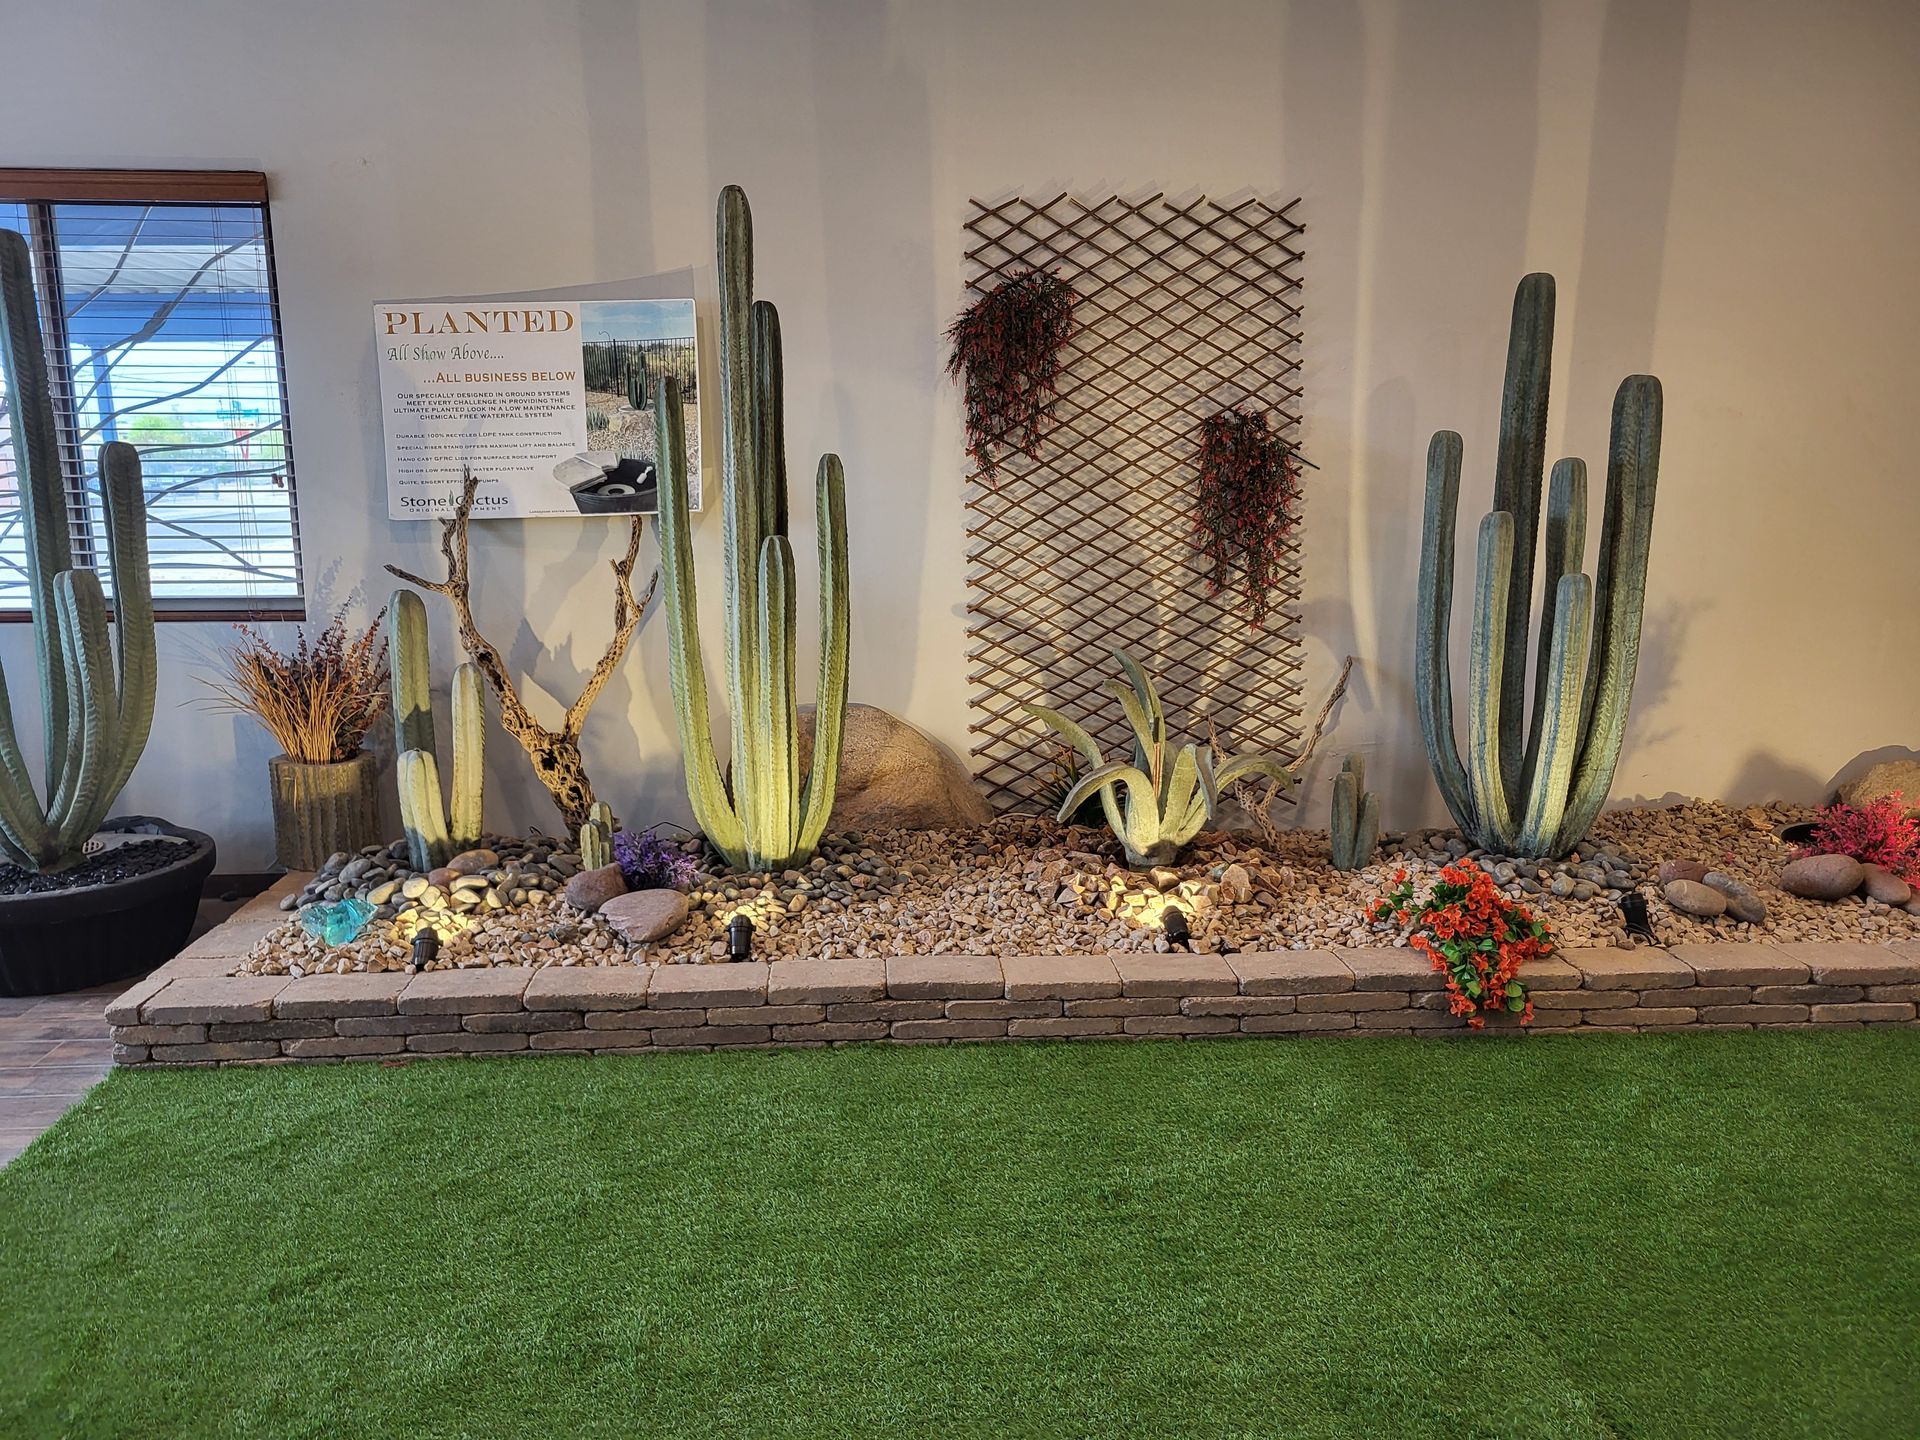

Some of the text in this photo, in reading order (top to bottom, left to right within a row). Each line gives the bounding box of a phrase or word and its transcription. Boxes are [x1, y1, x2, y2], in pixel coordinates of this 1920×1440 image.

[383, 310, 574, 334] PLANTED
[387, 344, 409, 361] All
[413, 343, 446, 361] Show
[465, 372, 527, 383] BUSINESS
[532, 371, 576, 382] BELOW
[400, 495, 509, 507] Stone Cctus
